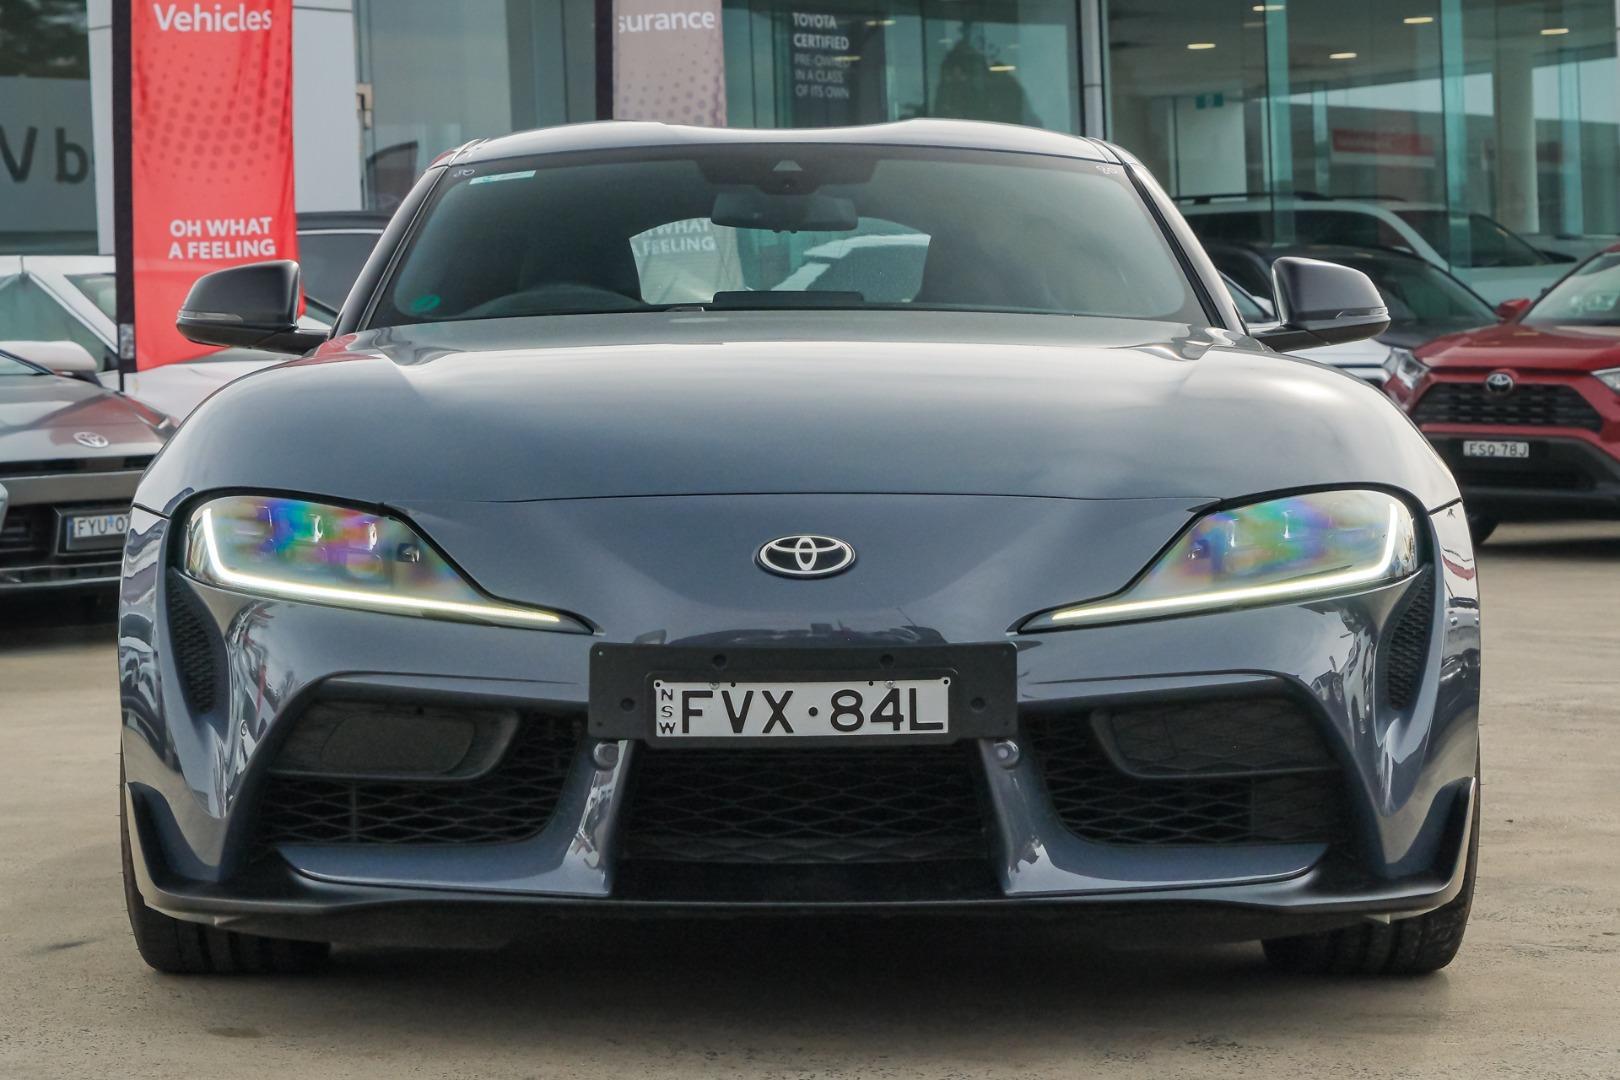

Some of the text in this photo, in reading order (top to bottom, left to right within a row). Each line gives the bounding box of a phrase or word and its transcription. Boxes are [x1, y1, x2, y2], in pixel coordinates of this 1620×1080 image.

[153, 3, 272, 32] Vehicles
[792, 12, 838, 29] TOYOTA
[793, 33, 850, 50] CERTIFIED
[795, 69, 844, 83] IN A CLASS
[795, 84, 850, 99] OF ITS OWN
[170, 216, 272, 237] OH WHAT
[168, 239, 276, 259] A FEELING
[642, 236, 718, 257] FEELING
